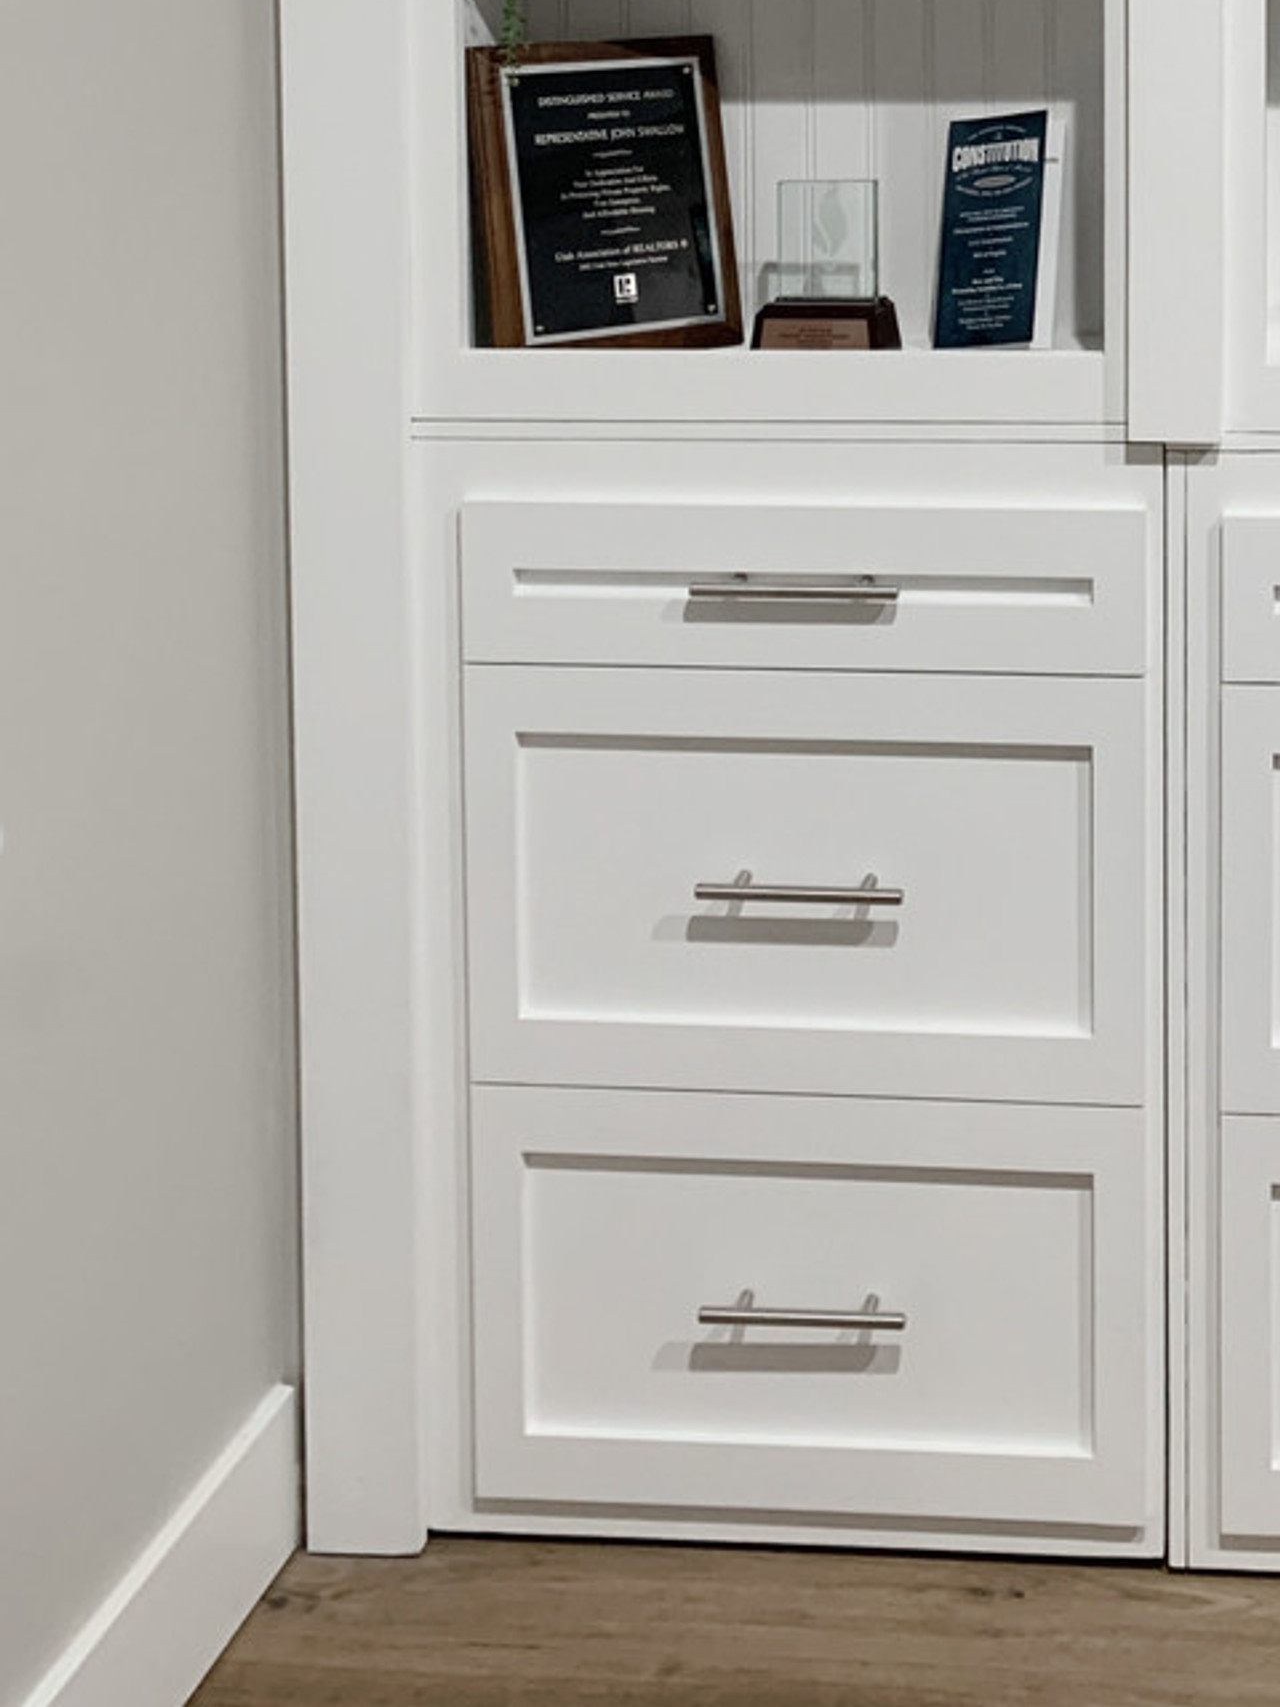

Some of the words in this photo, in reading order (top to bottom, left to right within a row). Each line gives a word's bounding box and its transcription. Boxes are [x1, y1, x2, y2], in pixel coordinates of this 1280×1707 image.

[538, 93, 605, 108] DISTINGUISHED
[607, 91, 641, 103] SERVICE
[534, 129, 609, 145] REPRESENTATIVE
[610, 126, 636, 142] JOHN
[952, 137, 1039, 172] CONSTITUTION
